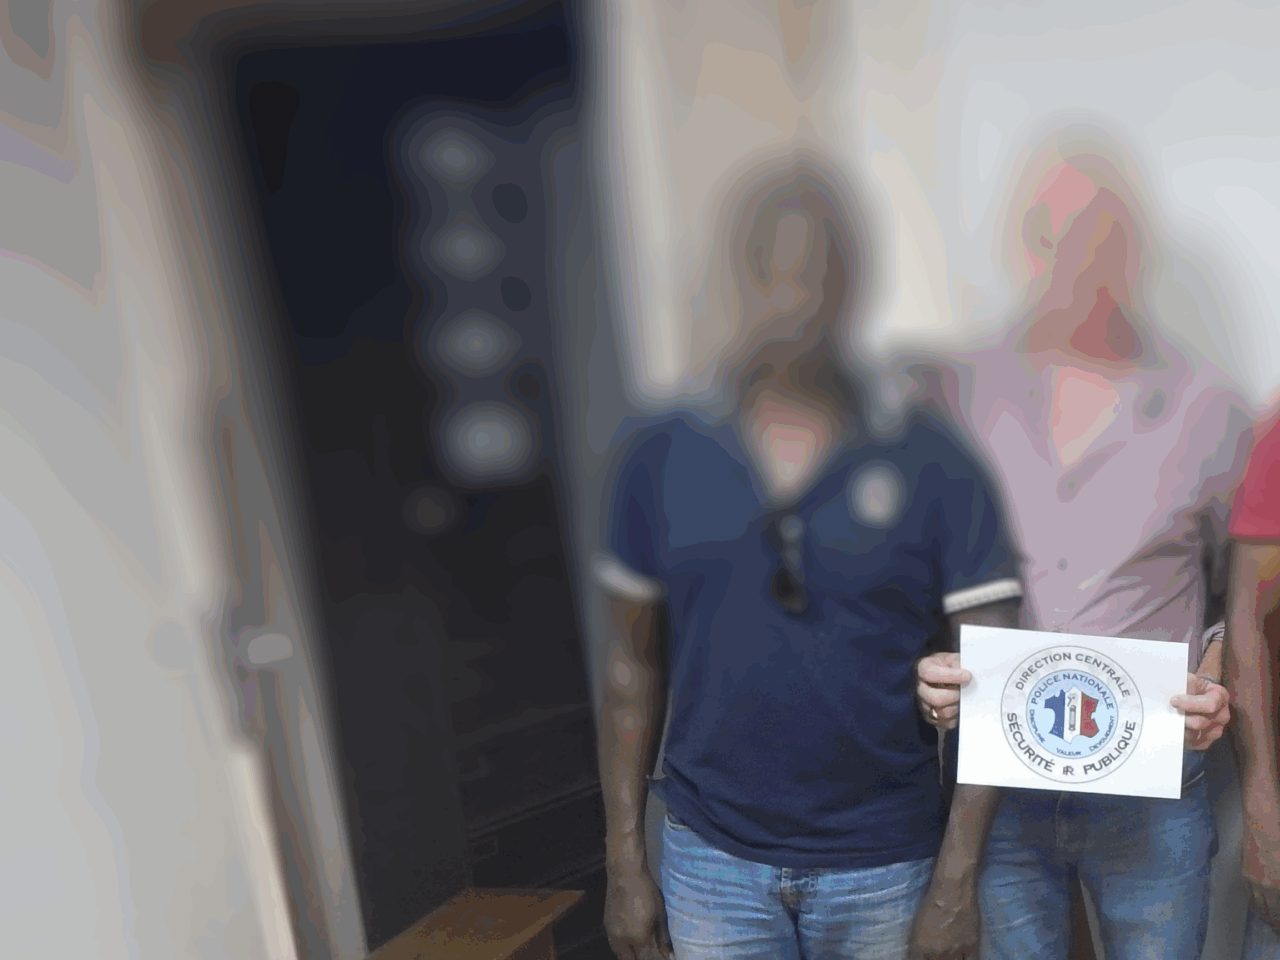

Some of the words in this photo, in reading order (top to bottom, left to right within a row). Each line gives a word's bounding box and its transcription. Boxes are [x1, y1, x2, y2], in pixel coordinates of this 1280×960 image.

[1015, 652, 1072, 690] DIRECTION
[1075, 653, 1131, 698] CENTRALE
[1031, 674, 1061, 705] POLICE
[1062, 673, 1115, 710] NATIONALE
[1006, 712, 1055, 773] SÉCURITÉ
[1083, 720, 1136, 775] PUBLIQUE
[1056, 747, 1082, 756] VALEUR
